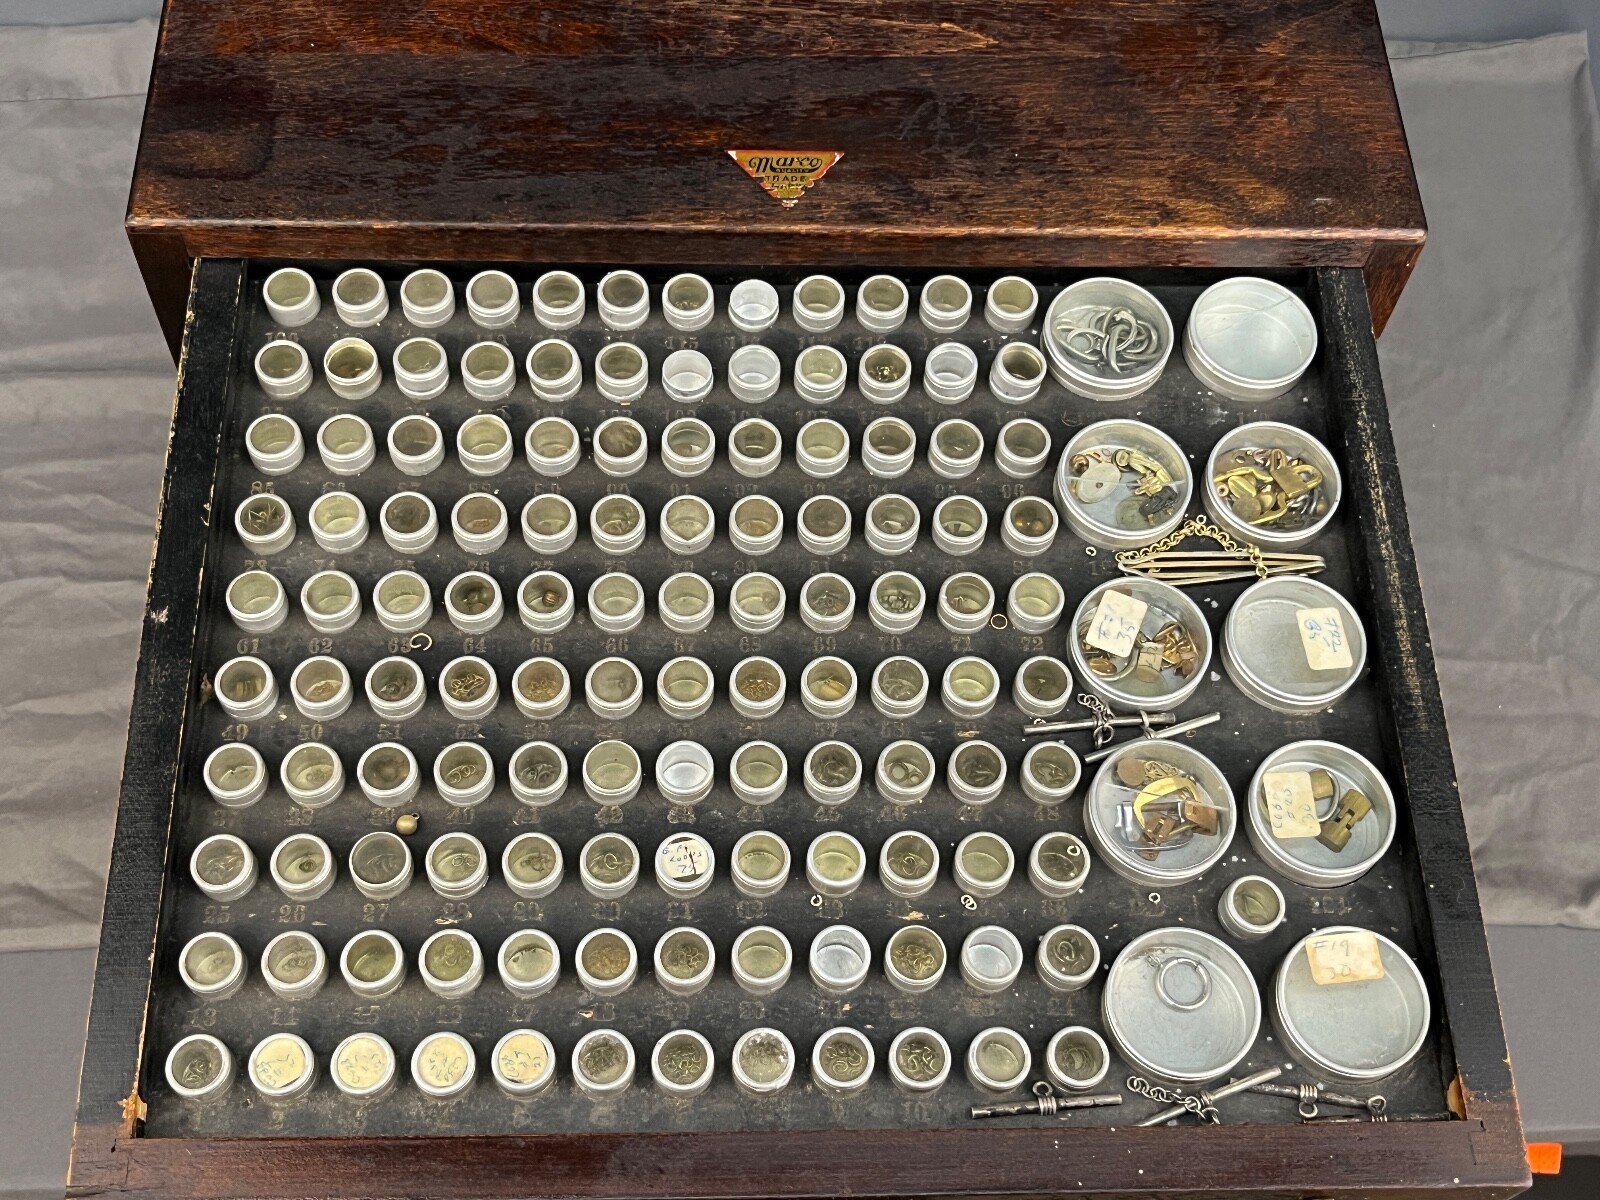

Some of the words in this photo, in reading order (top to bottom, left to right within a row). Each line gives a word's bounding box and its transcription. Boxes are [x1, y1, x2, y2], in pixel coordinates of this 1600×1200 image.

[236, 637, 260, 655] 61
[308, 637, 333, 655] 62
[387, 637, 412, 654] 63
[462, 637, 487, 654] 64
[529, 637, 554, 654] 65
[605, 637, 630, 653] 66
[673, 637, 697, 653] 67
[950, 636, 974, 652] 71
[1020, 636, 1044, 651] 72
[222, 723, 249, 741] 49
[203, 904, 231, 925] 25
[279, 903, 306, 924] 26
[362, 903, 389, 922] 27
